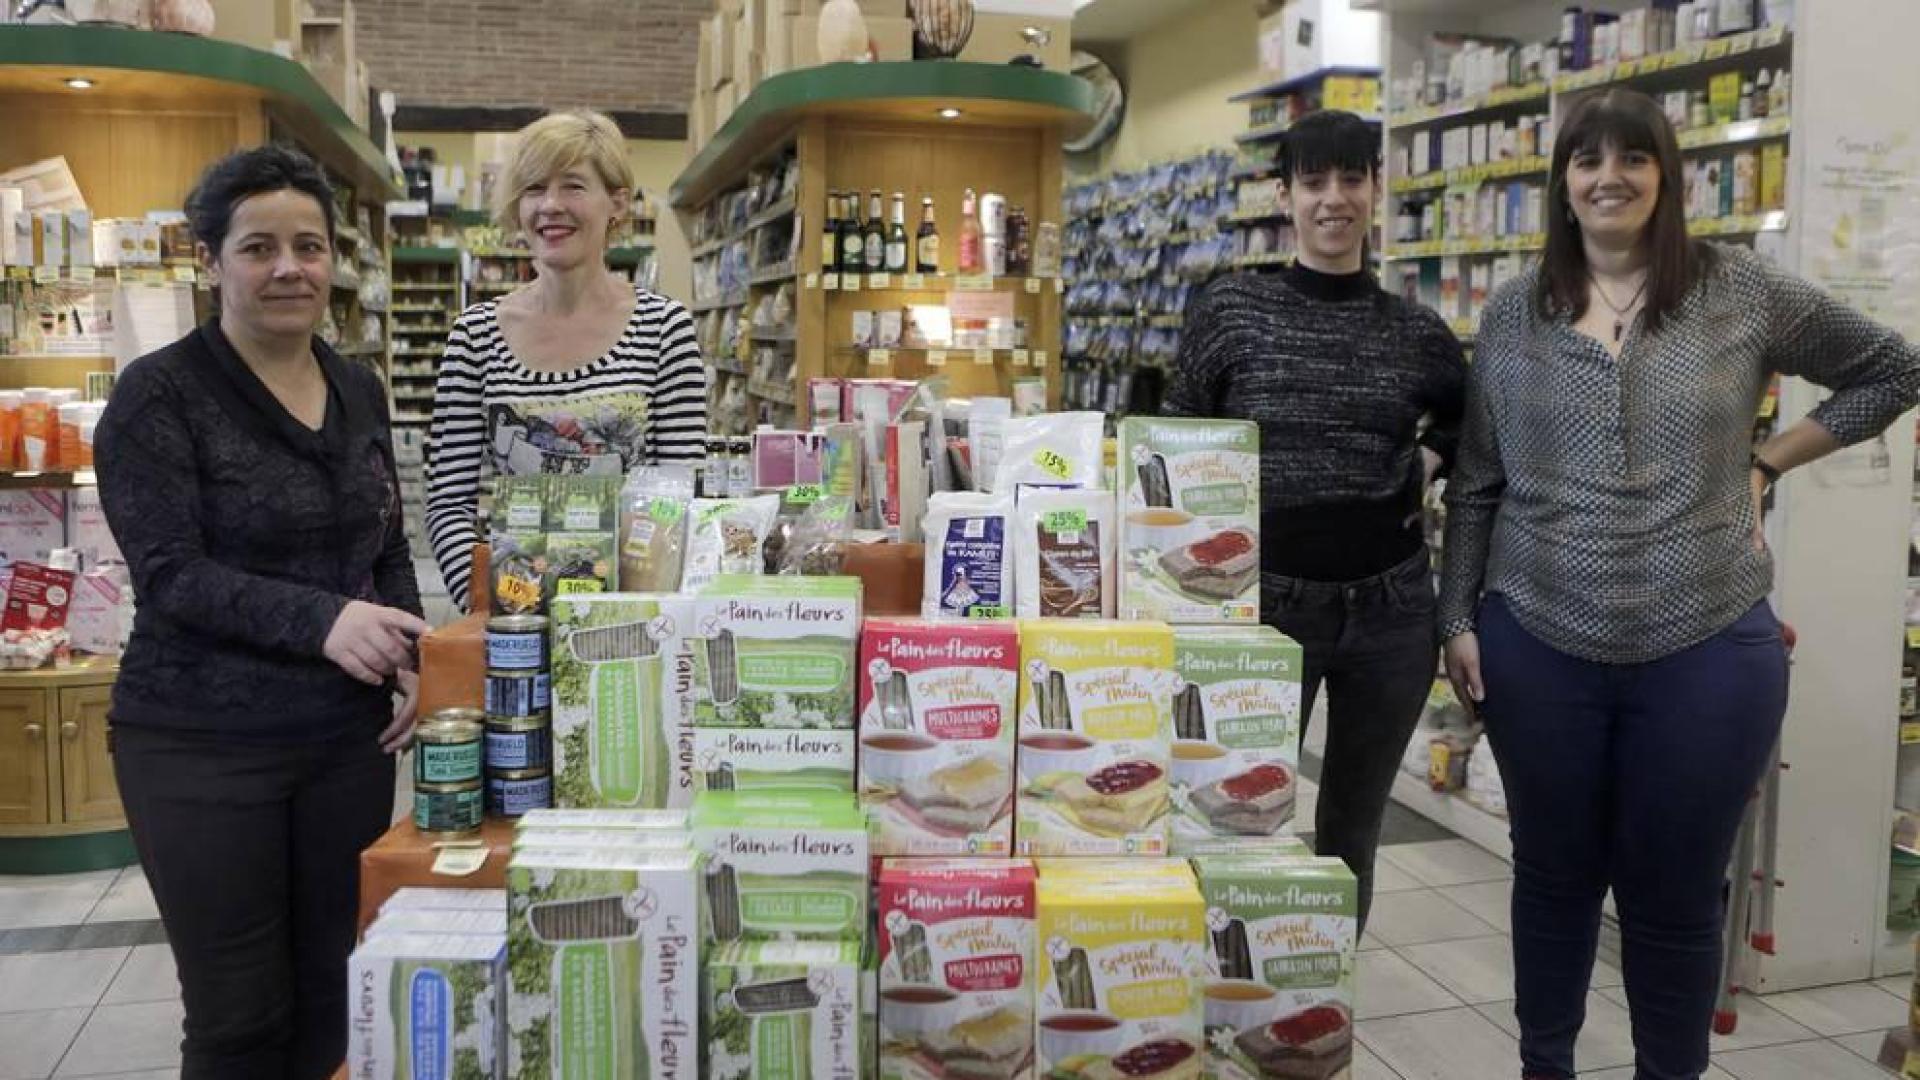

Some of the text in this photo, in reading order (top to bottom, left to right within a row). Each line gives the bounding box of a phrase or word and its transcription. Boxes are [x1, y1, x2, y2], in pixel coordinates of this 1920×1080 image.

[1050, 511, 1080, 528] 25%
[729, 600, 763, 622] Pain
[786, 600, 845, 622] fleurs
[890, 637, 924, 660] Pain
[944, 637, 1004, 659] fleurs
[728, 732, 763, 754] Pain
[786, 731, 843, 753] fleurs
[730, 830, 768, 855] Pain
[792, 831, 855, 855] fleurs
[908, 887, 943, 911] Pain
[963, 887, 1025, 909] fleurs
[657, 935, 689, 984] Pain
[660, 1013, 690, 1080] fleur
